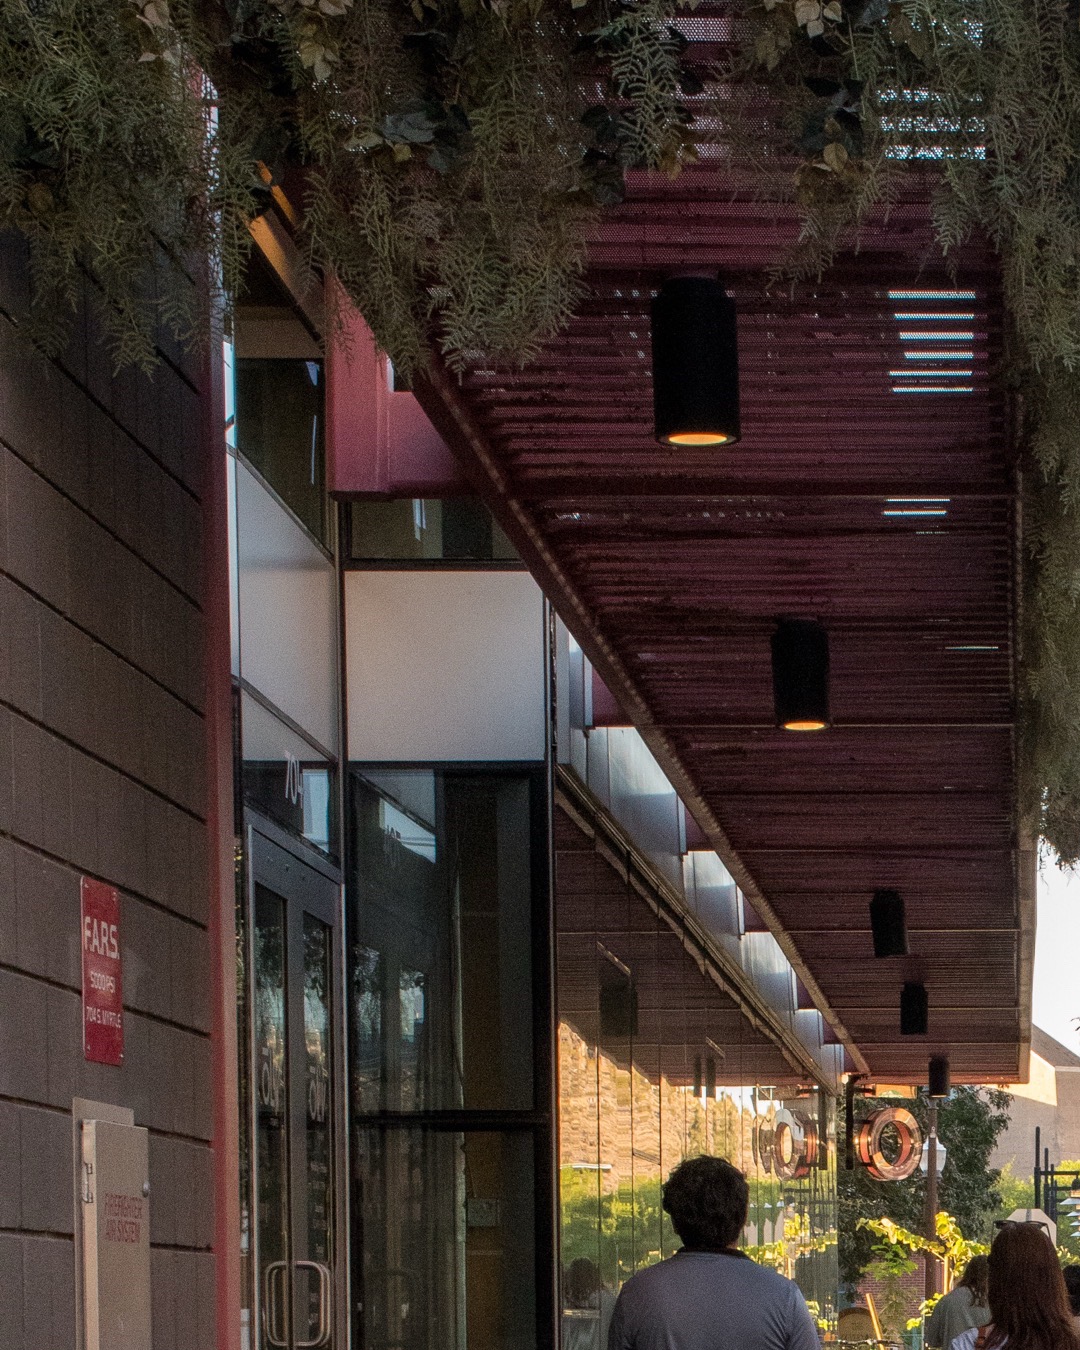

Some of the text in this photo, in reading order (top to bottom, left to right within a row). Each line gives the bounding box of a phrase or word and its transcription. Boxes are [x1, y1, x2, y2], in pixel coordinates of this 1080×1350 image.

[284, 749, 304, 809] 704
[104, 1191, 143, 1219] FIREFIGHTER
[117, 1219, 141, 1244] SYSTEM
